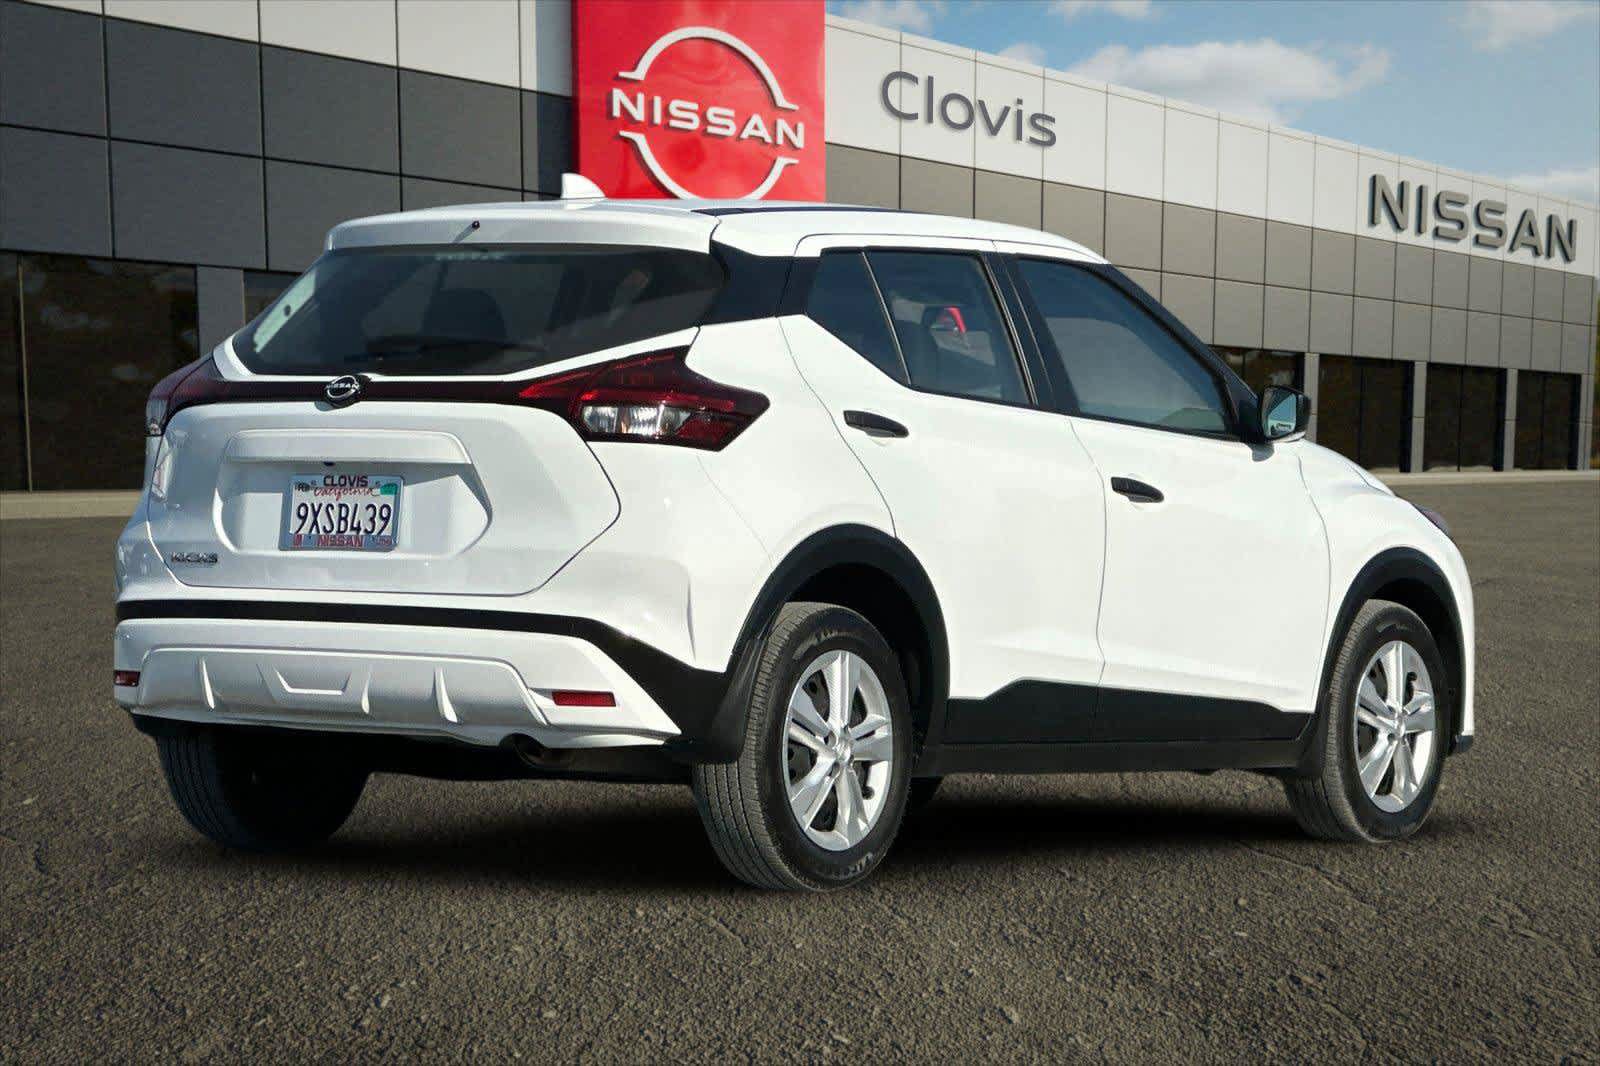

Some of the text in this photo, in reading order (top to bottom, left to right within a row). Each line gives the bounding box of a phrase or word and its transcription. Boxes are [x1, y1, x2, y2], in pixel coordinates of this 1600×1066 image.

[611, 87, 805, 149] NISSAN
[881, 70, 1057, 147] Clovis
[1368, 174, 1578, 264] NISSAN
[323, 475, 369, 487] CLOVIS
[295, 502, 393, 535] 9XSB439
[317, 534, 365, 548] NISSAN
